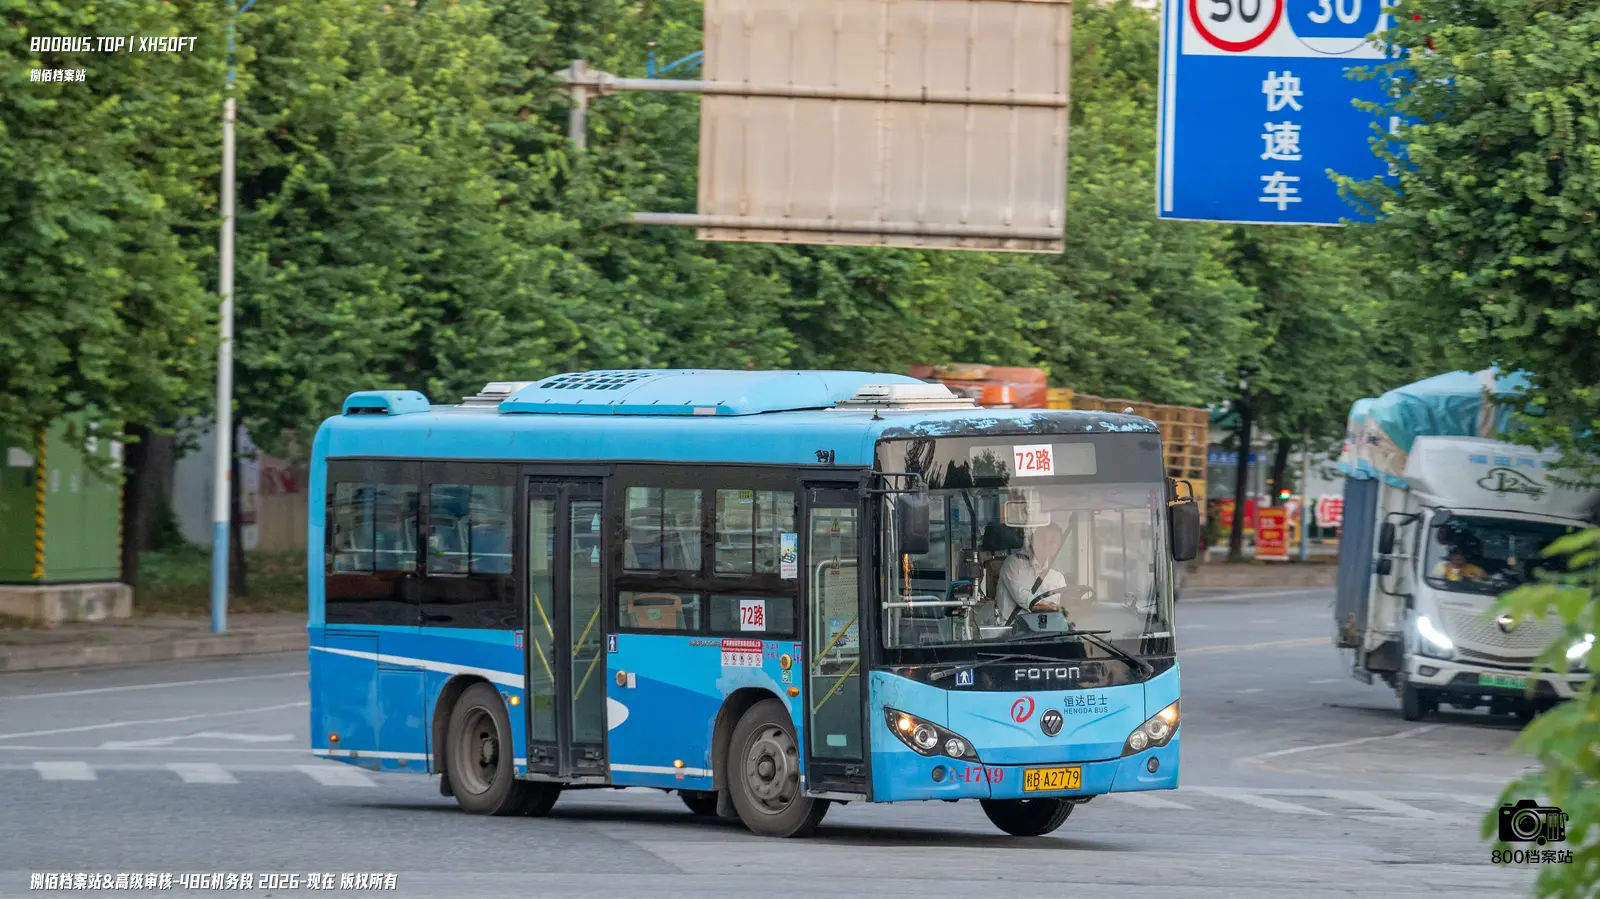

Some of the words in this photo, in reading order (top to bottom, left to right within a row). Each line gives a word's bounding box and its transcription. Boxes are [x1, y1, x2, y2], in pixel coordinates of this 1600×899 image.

[1259, 70, 1303, 211] 快速车
[1015, 448, 1051, 471] 72路
[741, 605, 763, 626] 72路
[1014, 667, 1080, 681] FOTON
[1063, 694, 1108, 707] 恒达巴士
[1063, 707, 1093, 715] HENGDA
[1094, 706, 1108, 714] BUS
